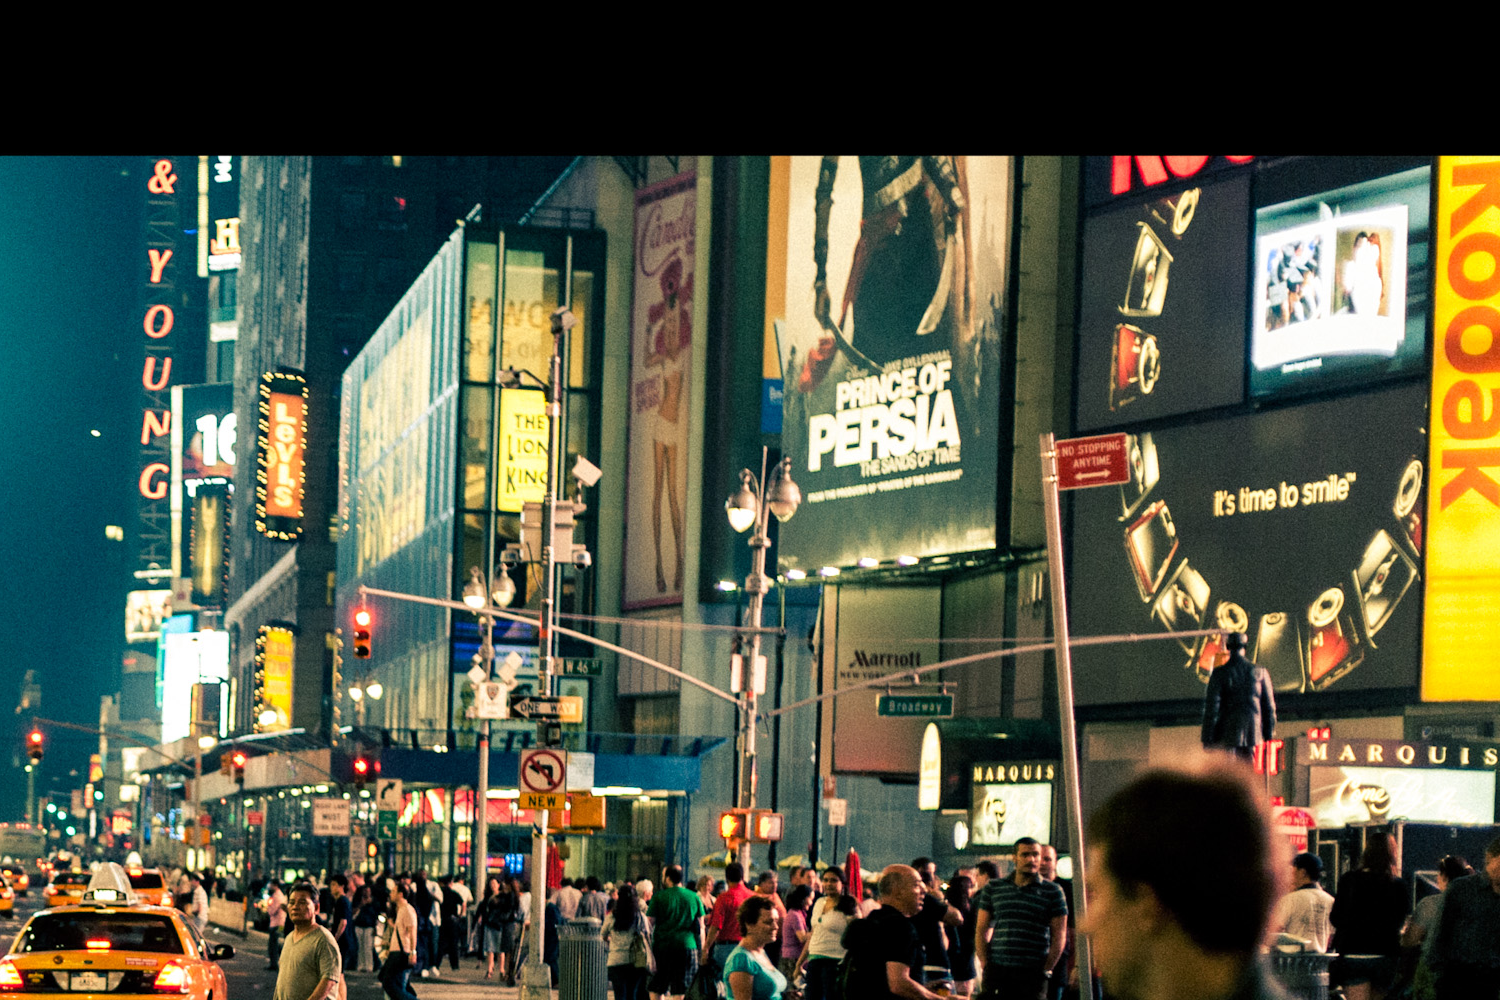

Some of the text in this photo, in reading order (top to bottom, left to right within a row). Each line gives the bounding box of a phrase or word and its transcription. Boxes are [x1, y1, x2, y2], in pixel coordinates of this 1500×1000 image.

[147, 158, 178, 194] &
[139, 249, 175, 500] YOUNG
[836, 359, 953, 411] PRINCE OF
[515, 414, 545, 429] THE
[808, 389, 961, 473] PERSIA
[1061, 440, 1121, 457] NO STOPPING
[861, 447, 961, 478] THE SANDS OF TIME
[1072, 454, 1112, 468] ANYTIME
[1214, 489, 1236, 517] it's
[1239, 485, 1278, 513] time
[1280, 481, 1299, 508] to
[566, 660, 574, 673] W
[577, 660, 588, 674] 46
[850, 650, 921, 668] Marriott
[840, 670, 859, 679] NEW
[520, 702, 577, 715] ONE WAY
[888, 700, 943, 713] Broadway
[1309, 743, 1499, 766] MARQUIS
[972, 764, 1055, 782] MARQUIS
[528, 796, 556, 807] NEW
[1335, 776, 1392, 815] Come
[1294, 815, 1310, 826] NOT
